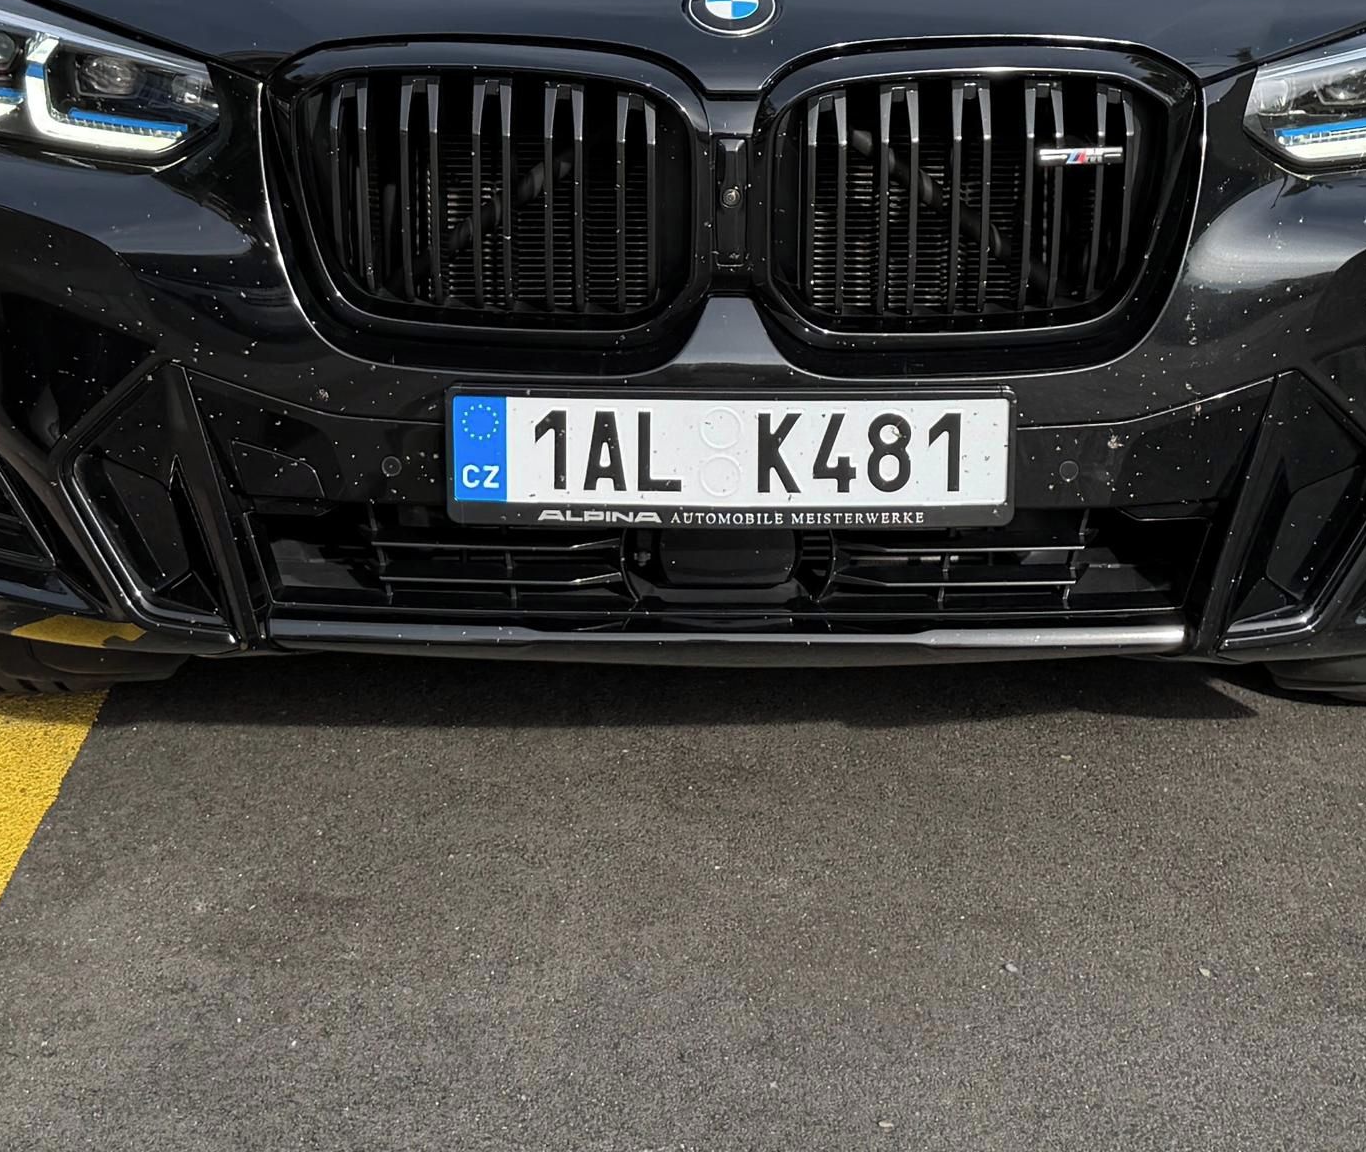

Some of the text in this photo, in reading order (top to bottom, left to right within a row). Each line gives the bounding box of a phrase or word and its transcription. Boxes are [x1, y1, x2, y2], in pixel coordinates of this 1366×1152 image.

[534, 410, 964, 494] 1AL K481
[462, 464, 500, 490] CZ
[537, 508, 926, 526] ALPINA AUTOMOBILE MEISTERWERKE
